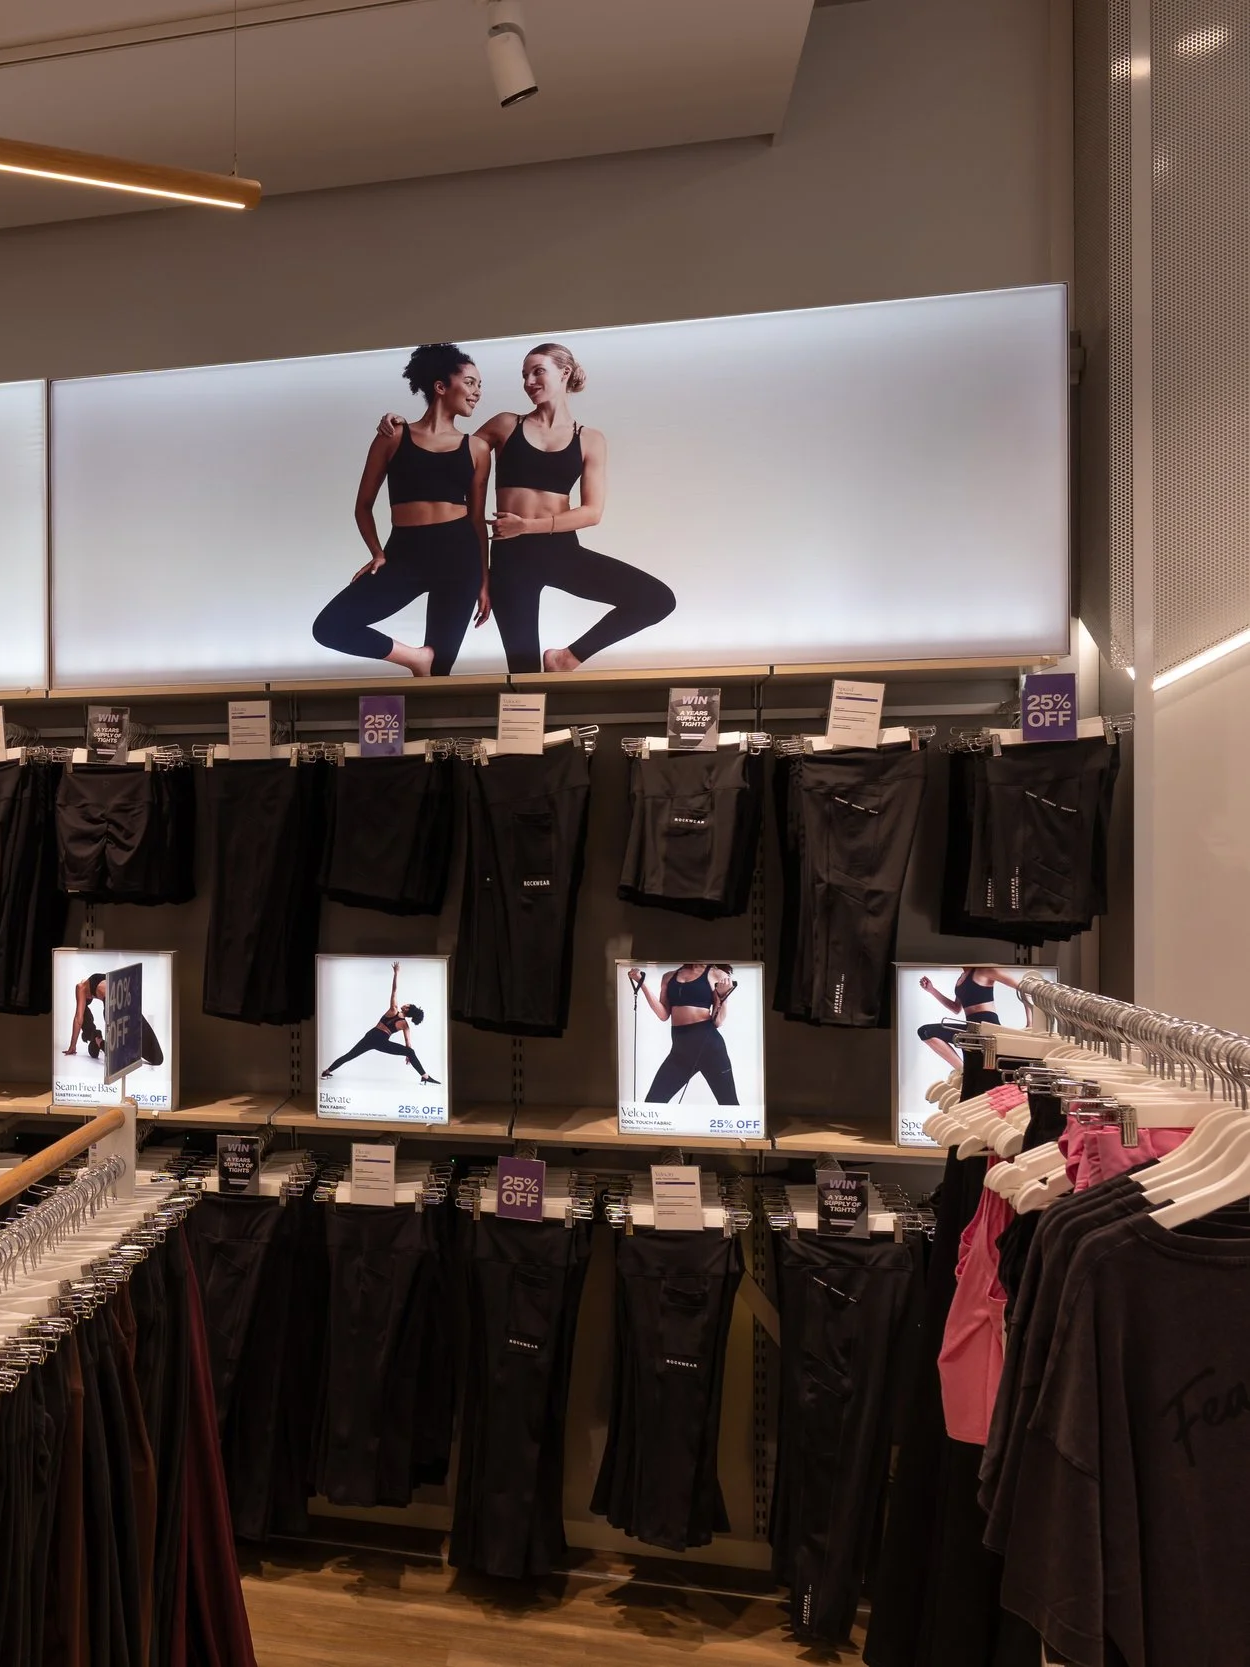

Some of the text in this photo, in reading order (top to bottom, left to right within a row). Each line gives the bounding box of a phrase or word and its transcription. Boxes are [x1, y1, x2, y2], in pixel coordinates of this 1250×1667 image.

[682, 696, 708, 705] WIN
[1027, 693, 1071, 710] 25%
[98, 714, 119, 723] WIN
[364, 714, 399, 730] 25%
[1027, 710, 1071, 727] OFF
[364, 729, 399, 745] OFF
[674, 817, 705, 825] ROCKWEAR
[523, 879, 550, 887] ROCKWEAR
[110, 977, 132, 1012] 40%
[55, 1081, 117, 1093] Seam Free Base
[150, 1095, 168, 1103] OFF
[319, 1092, 351, 1104] Elevate
[398, 1105, 444, 1115] 25% OFF
[621, 1106, 660, 1119] Velocity
[710, 1119, 760, 1129] 25% OFF
[901, 1118, 922, 1131] Spe
[228, 1144, 250, 1152] WIN
[502, 1175, 539, 1193] 25%
[829, 1179, 856, 1189] WIN
[502, 1191, 538, 1207] OFF
[666, 1359, 698, 1368] ROCKWEAR
[1157, 1365, 1250, 1469] Fea
